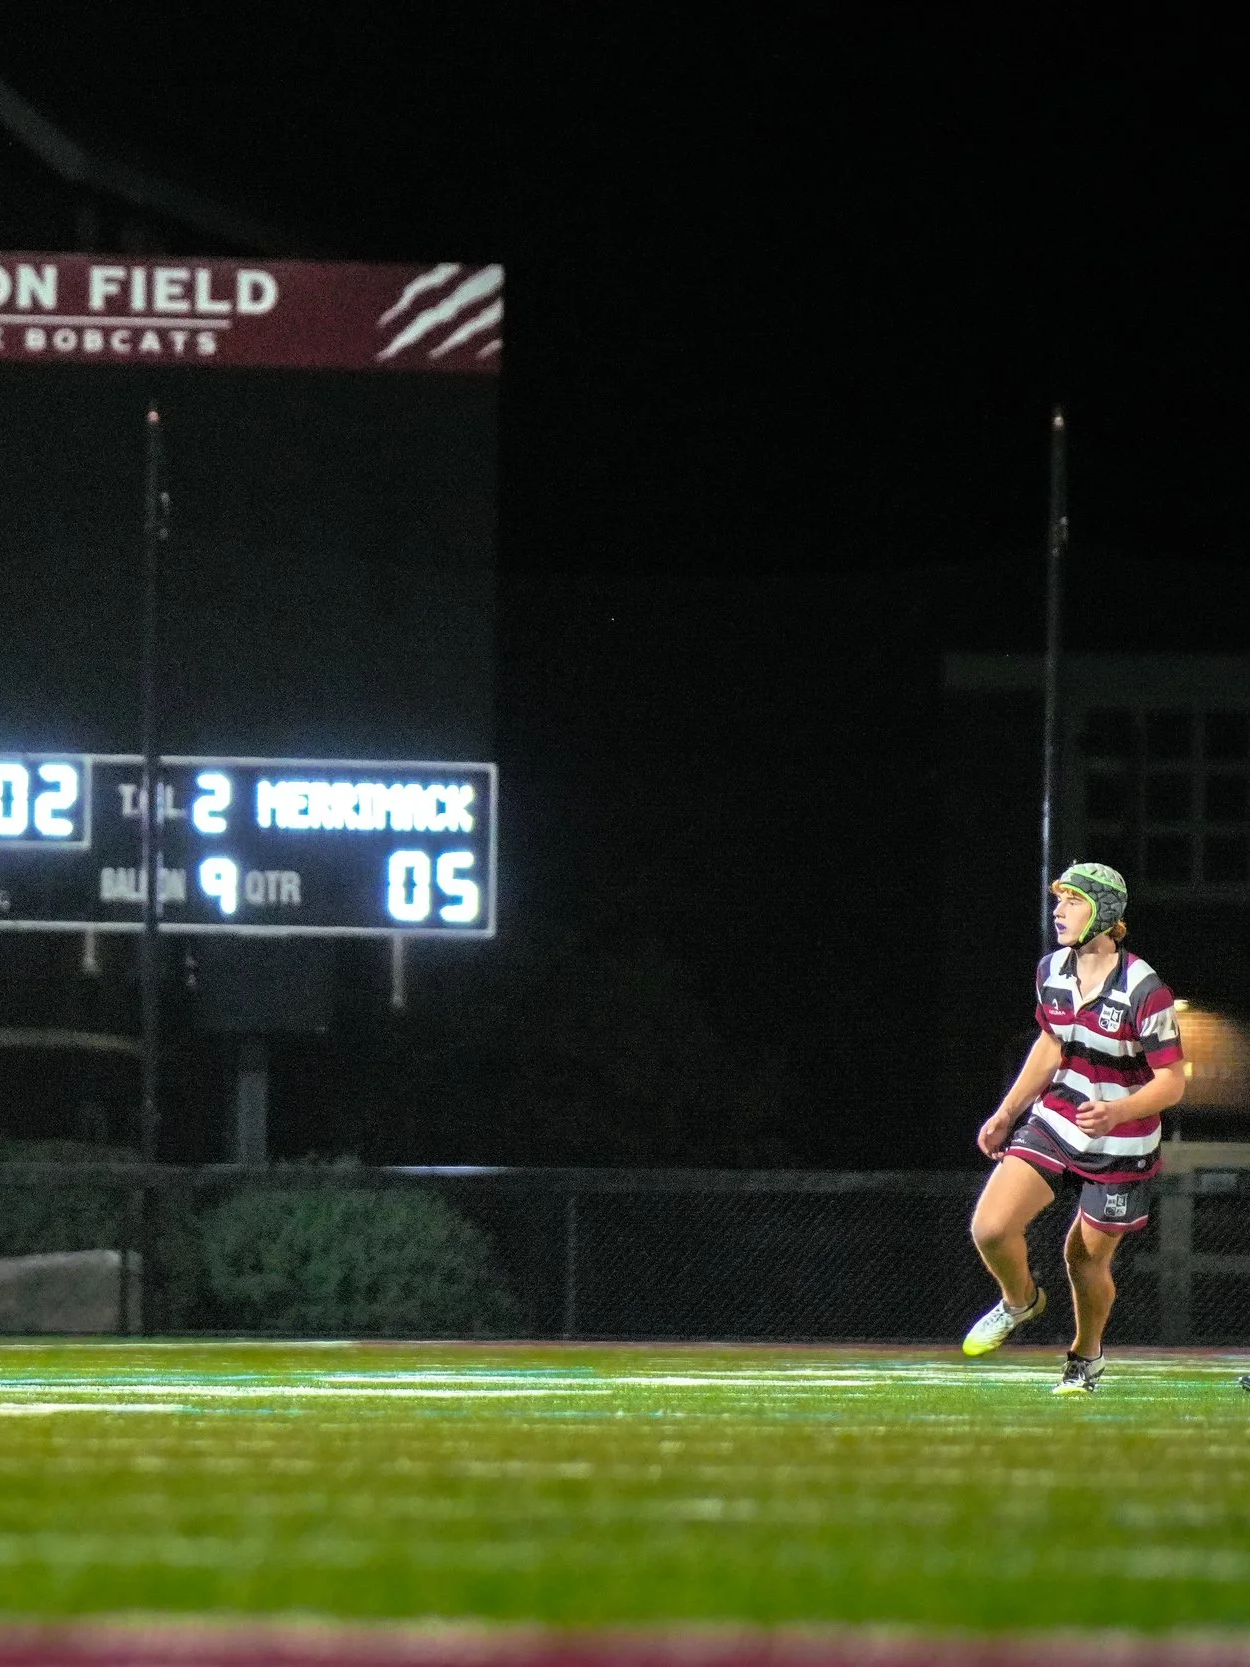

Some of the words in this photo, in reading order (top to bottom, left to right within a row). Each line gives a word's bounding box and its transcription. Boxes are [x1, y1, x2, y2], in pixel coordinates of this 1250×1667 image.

[88, 264, 279, 315] FIELD
[24, 327, 218, 356] BOBCATS
[192, 771, 233, 834] 2
[199, 856, 239, 915] 9
[246, 870, 301, 904] QTR
[388, 850, 480, 923] 05
